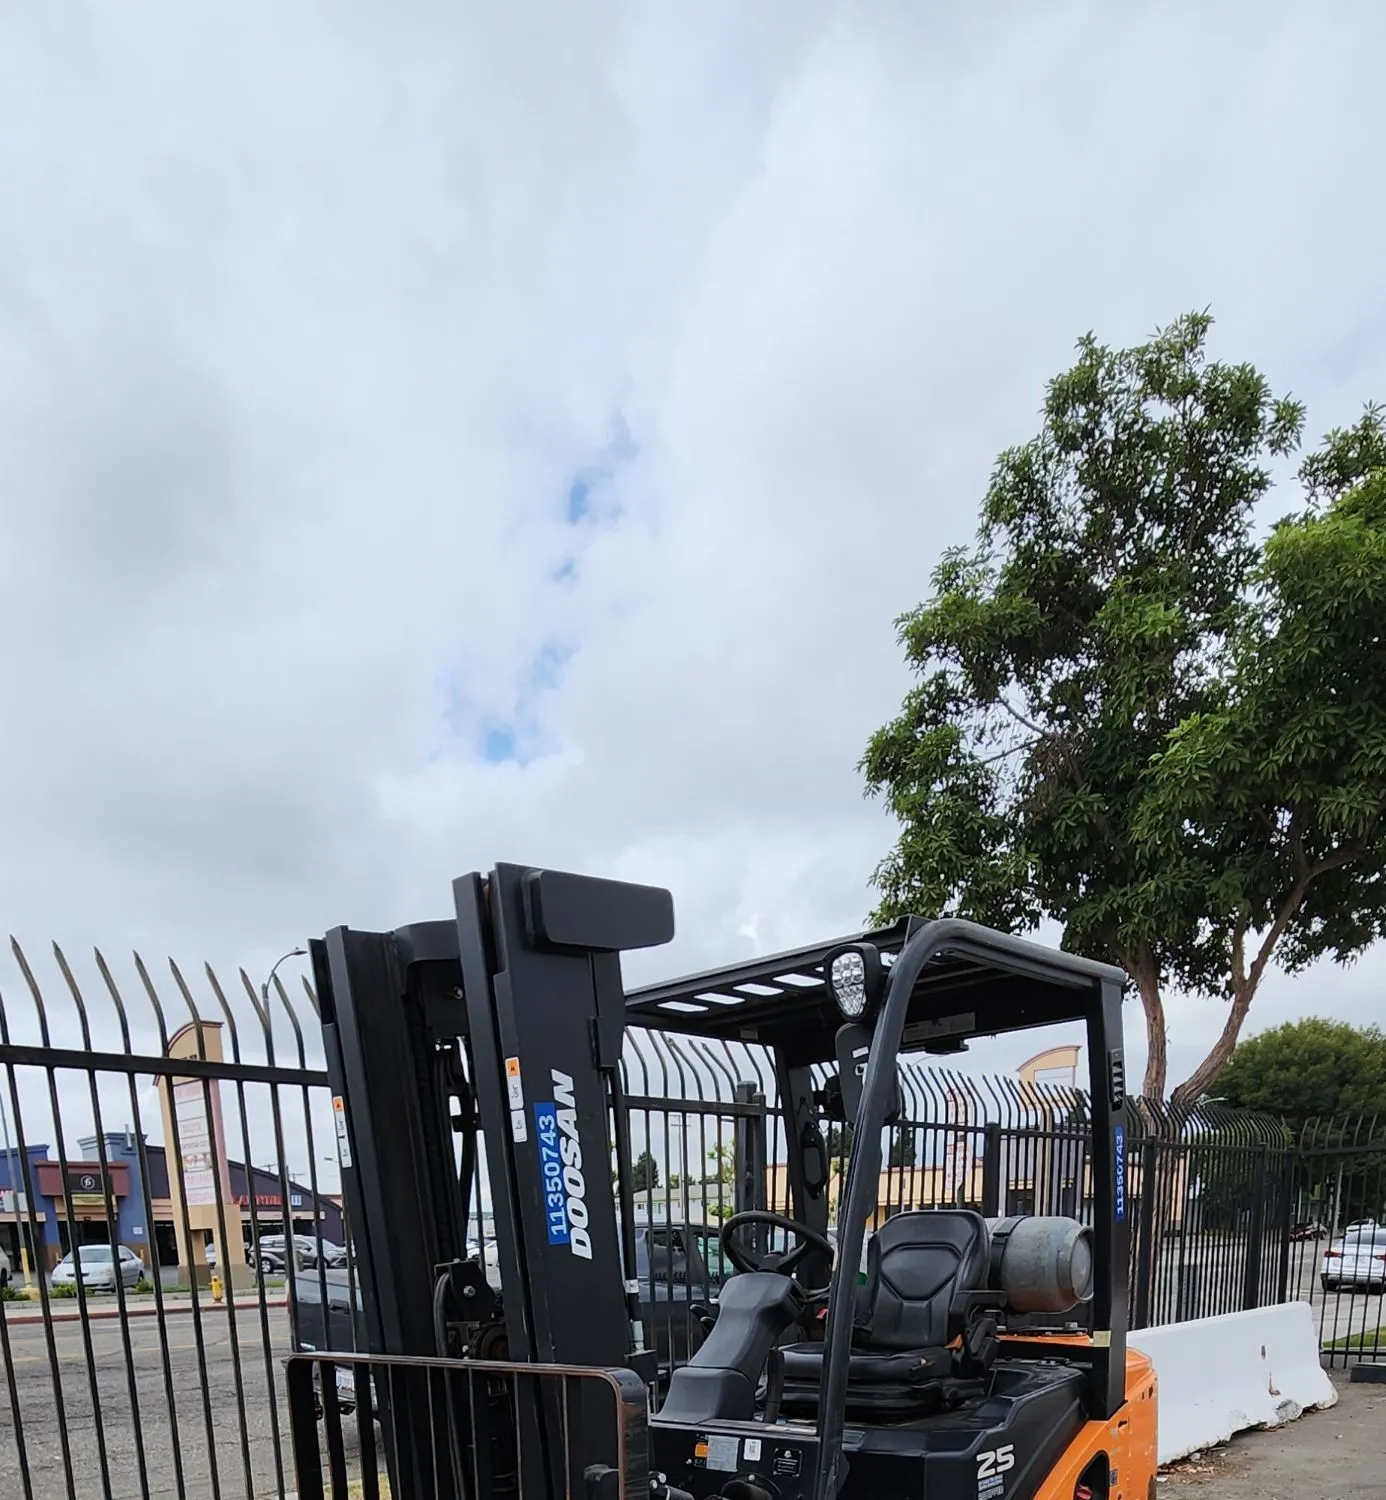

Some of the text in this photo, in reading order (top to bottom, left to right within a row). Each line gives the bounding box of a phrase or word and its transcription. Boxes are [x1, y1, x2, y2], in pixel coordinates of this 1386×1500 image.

[539, 1114, 567, 1236] 11350743
[551, 1068, 593, 1260] DOOSAN
[1116, 1135, 1124, 1215] 11350743
[976, 1444, 1015, 1480] 25
